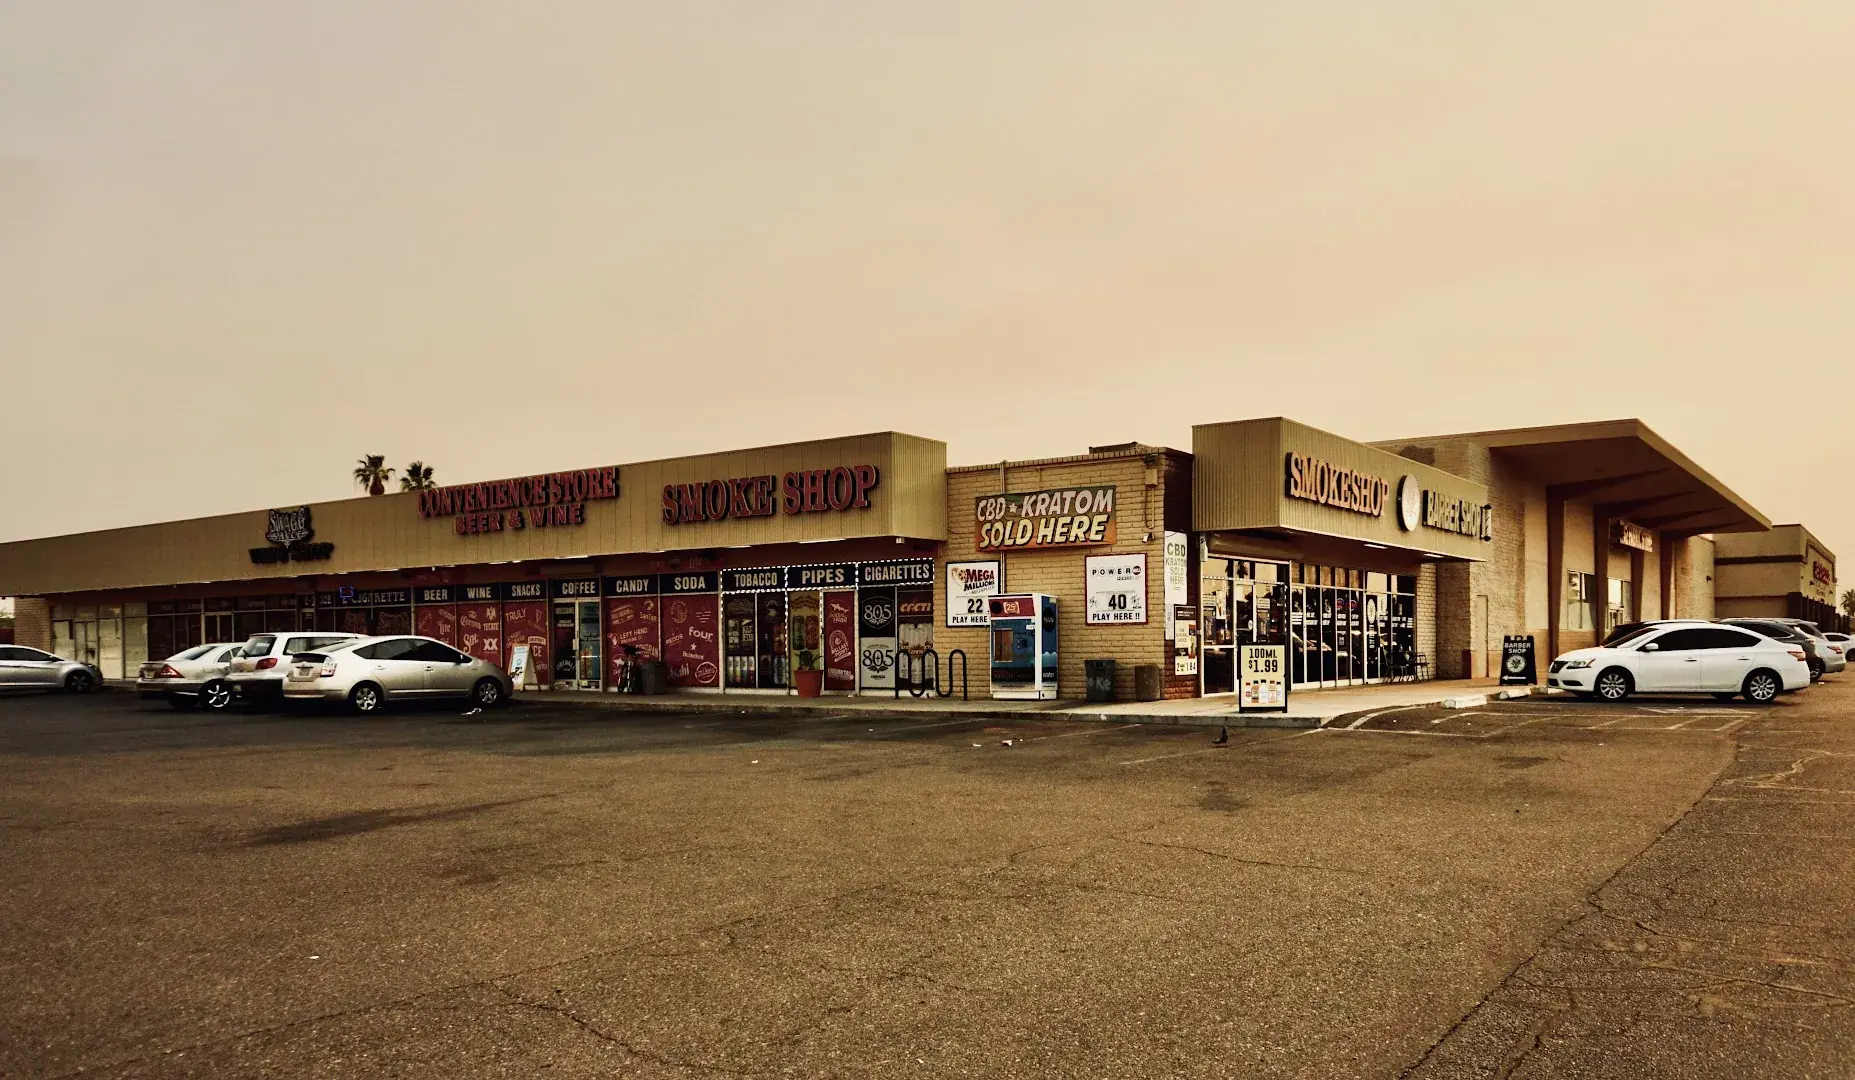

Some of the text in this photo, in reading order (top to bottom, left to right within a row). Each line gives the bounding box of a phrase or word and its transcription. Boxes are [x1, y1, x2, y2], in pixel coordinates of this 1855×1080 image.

[417, 467, 617, 518] CONVENIENCE STORE
[662, 464, 877, 524] SMOKE SHOP
[977, 489, 1113, 521] CBD KRATOM
[1424, 490, 1462, 533] BARBER
[455, 504, 583, 533] BEER & WINE
[979, 514, 1109, 548] SOLD HERE
[1167, 543, 1186, 557] CBD
[735, 572, 778, 587] TOBACCO
[801, 568, 845, 584] PIPES
[864, 564, 930, 581] CIGARETTES
[965, 569, 995, 583] MEGA
[511, 584, 541, 597] SNACKS
[562, 581, 596, 595] COFFEE
[616, 579, 650, 593] CANDY
[674, 576, 706, 590] SODA
[963, 580, 995, 592] MILLIONS
[424, 589, 448, 600] BEER
[467, 587, 492, 598] WINE
[967, 598, 983, 613] 22
[1108, 594, 1127, 610] 40
[505, 608, 527, 623] TRULY
[864, 604, 893, 620] 805
[1113, 612, 1133, 620] HERE
[862, 649, 895, 668] 805
[1249, 648, 1278, 659] 100ML
[1248, 659, 1278, 673] $1.99
